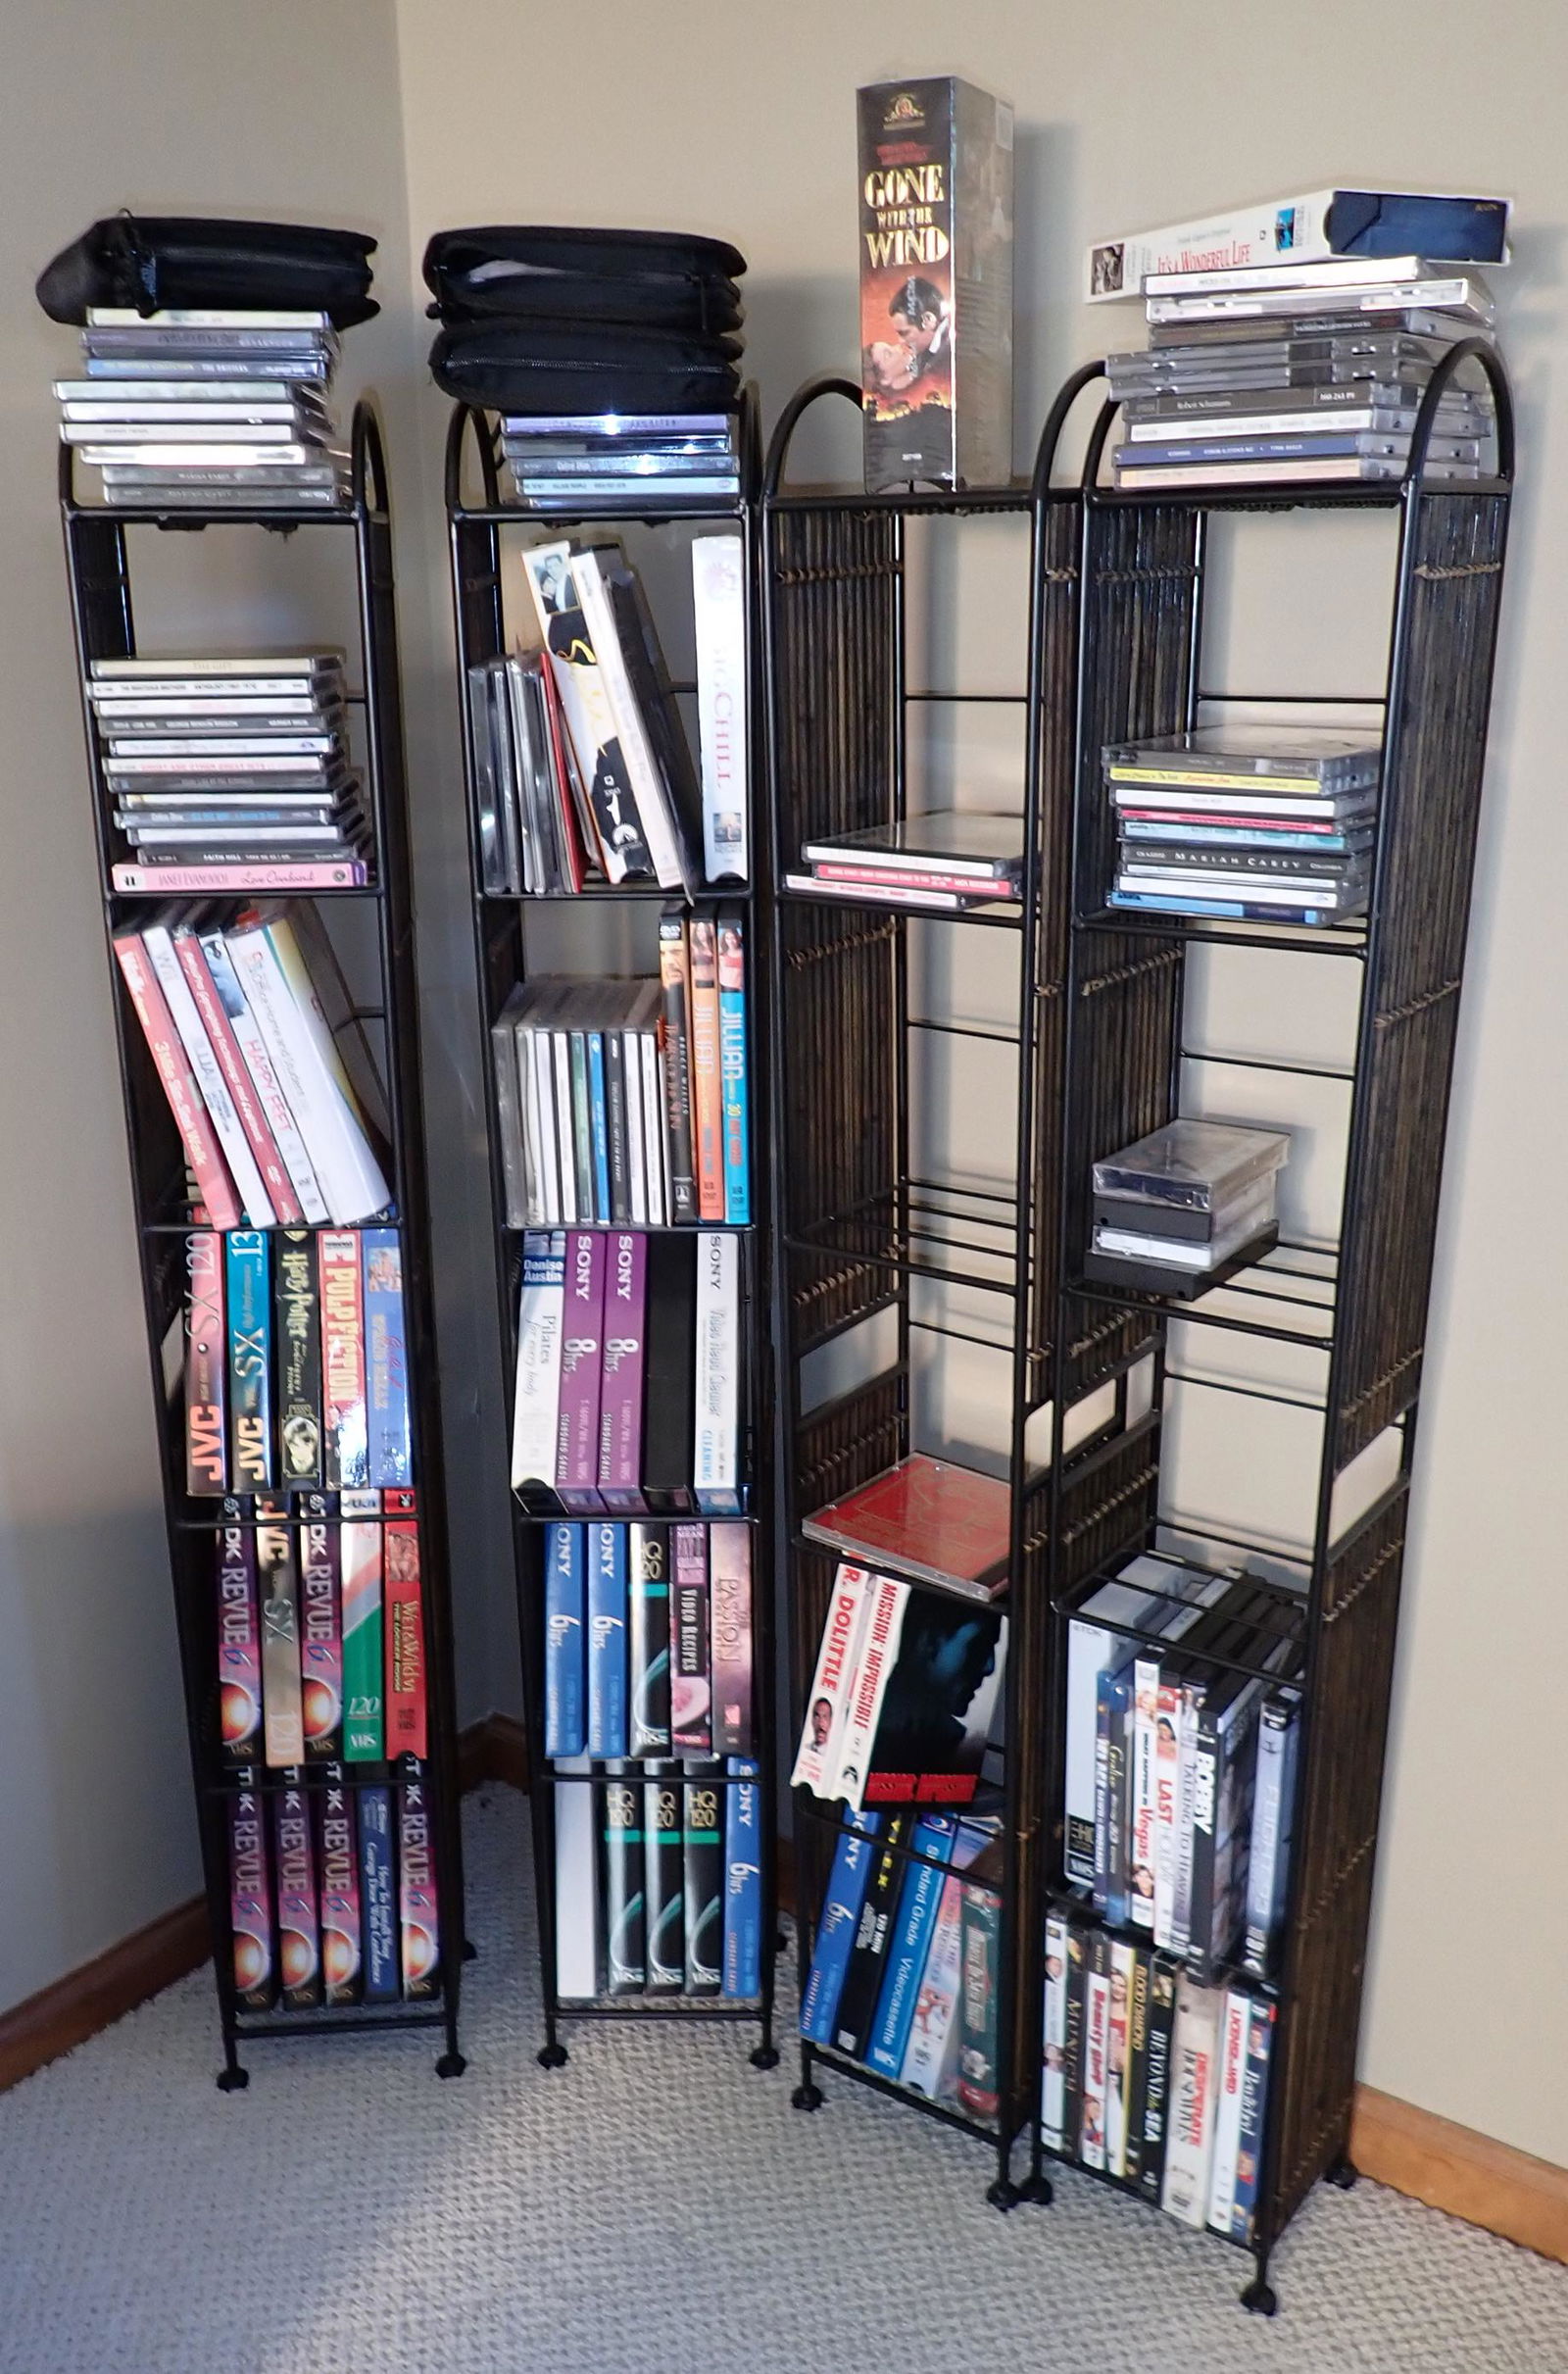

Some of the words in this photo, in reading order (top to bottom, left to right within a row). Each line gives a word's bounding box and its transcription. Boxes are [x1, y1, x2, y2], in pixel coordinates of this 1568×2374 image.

[864, 164, 945, 209] GONE
[864, 226, 950, 269] WIND
[876, 209, 905, 229] WITH
[714, 692, 733, 790] CHILL
[1174, 853, 1240, 865] MARIAH
[1248, 858, 1300, 868] CAREY
[244, 1039, 277, 1097] HAPPY
[721, 1007, 745, 1080] JILLIAN
[185, 1232, 216, 1277] 120
[281, 1252, 310, 1293] Harry
[523, 1259, 564, 1270] Denise
[523, 1270, 564, 1283] Austin
[575, 1235, 592, 1301] SONY
[617, 1235, 633, 1301] SONY
[710, 1235, 721, 1290] SONY
[275, 1292, 315, 1339] Potter
[325, 1267, 357, 1319] PULP
[233, 1327, 265, 1378] SX
[327, 1320, 360, 1402] FICTION
[541, 1314, 557, 1364] Pilates
[189, 1405, 223, 1481] JVC
[238, 1416, 265, 1481] JVC
[221, 1565, 250, 1644] REVUE
[306, 1564, 334, 1643] REVUE
[680, 1589, 698, 1623] VIDEO
[715, 1577, 742, 1662] PASSION
[681, 1626, 698, 1672] RECIPES
[820, 1597, 856, 1693] DOLITTLE
[854, 1645, 884, 1731] IMPOSSIBLE
[1156, 1779, 1173, 1825] LAST
[1178, 1761, 1194, 1828] TALKING
[1195, 1752, 1216, 1835] BOBBY
[233, 1820, 261, 1896] REVUE
[280, 1817, 307, 1892] REVUE
[322, 1818, 351, 1893] REVUE
[402, 1813, 429, 1888] REVUE
[1136, 1806, 1154, 1859] Vegas
[1177, 1832, 1190, 1852] TO
[916, 1844, 940, 1906] Stndard
[1174, 1854, 1190, 1920] HEAVEN
[906, 1904, 924, 1948] Grade
[883, 1957, 914, 2046] Videocassette
[1065, 1998, 1083, 2093] MUNICH
[1148, 2029, 1168, 2098] BEYOND
[1145, 2109, 1164, 2144] SEA
